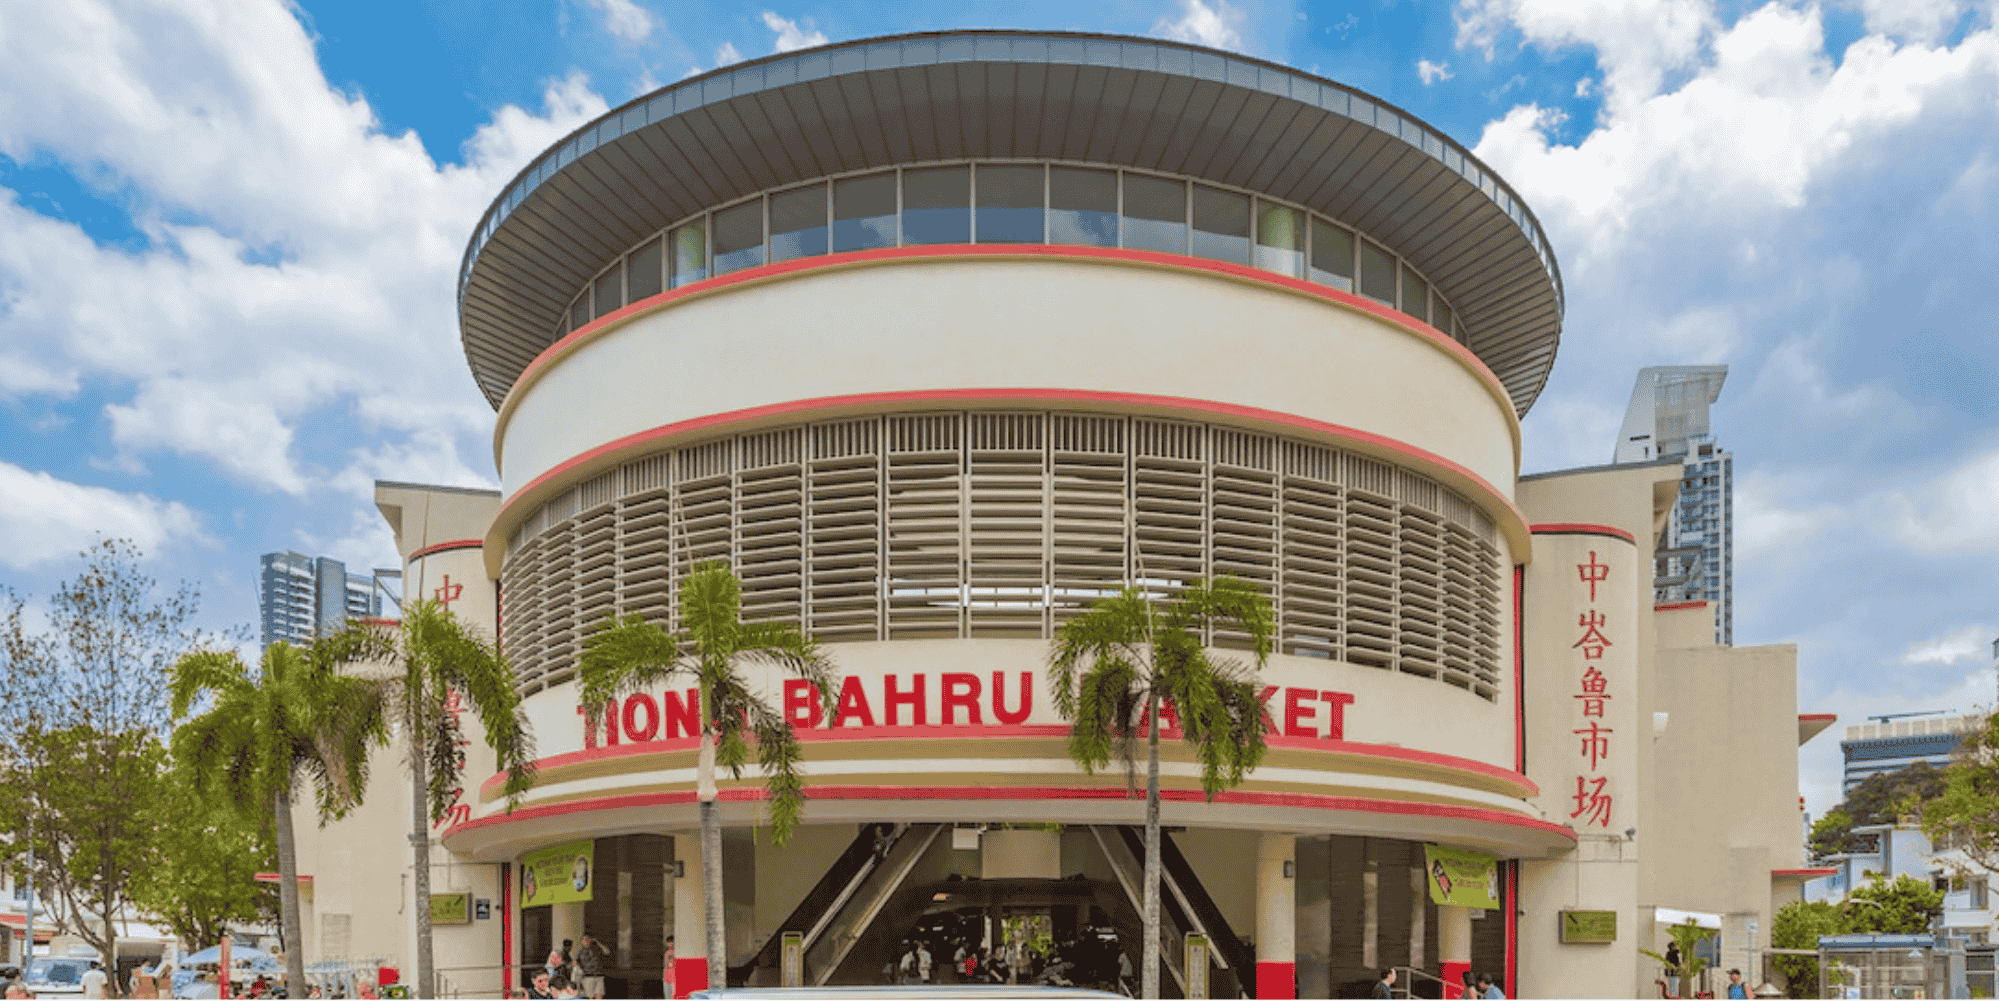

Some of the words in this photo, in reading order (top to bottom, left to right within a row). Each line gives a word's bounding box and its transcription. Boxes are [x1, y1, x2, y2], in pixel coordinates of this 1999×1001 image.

[576, 687, 754, 750] TION
[783, 670, 1033, 729] BAHRU
[1080, 674, 1355, 741] AKET
[1570, 550, 1613, 828] 中峇鲁市场
